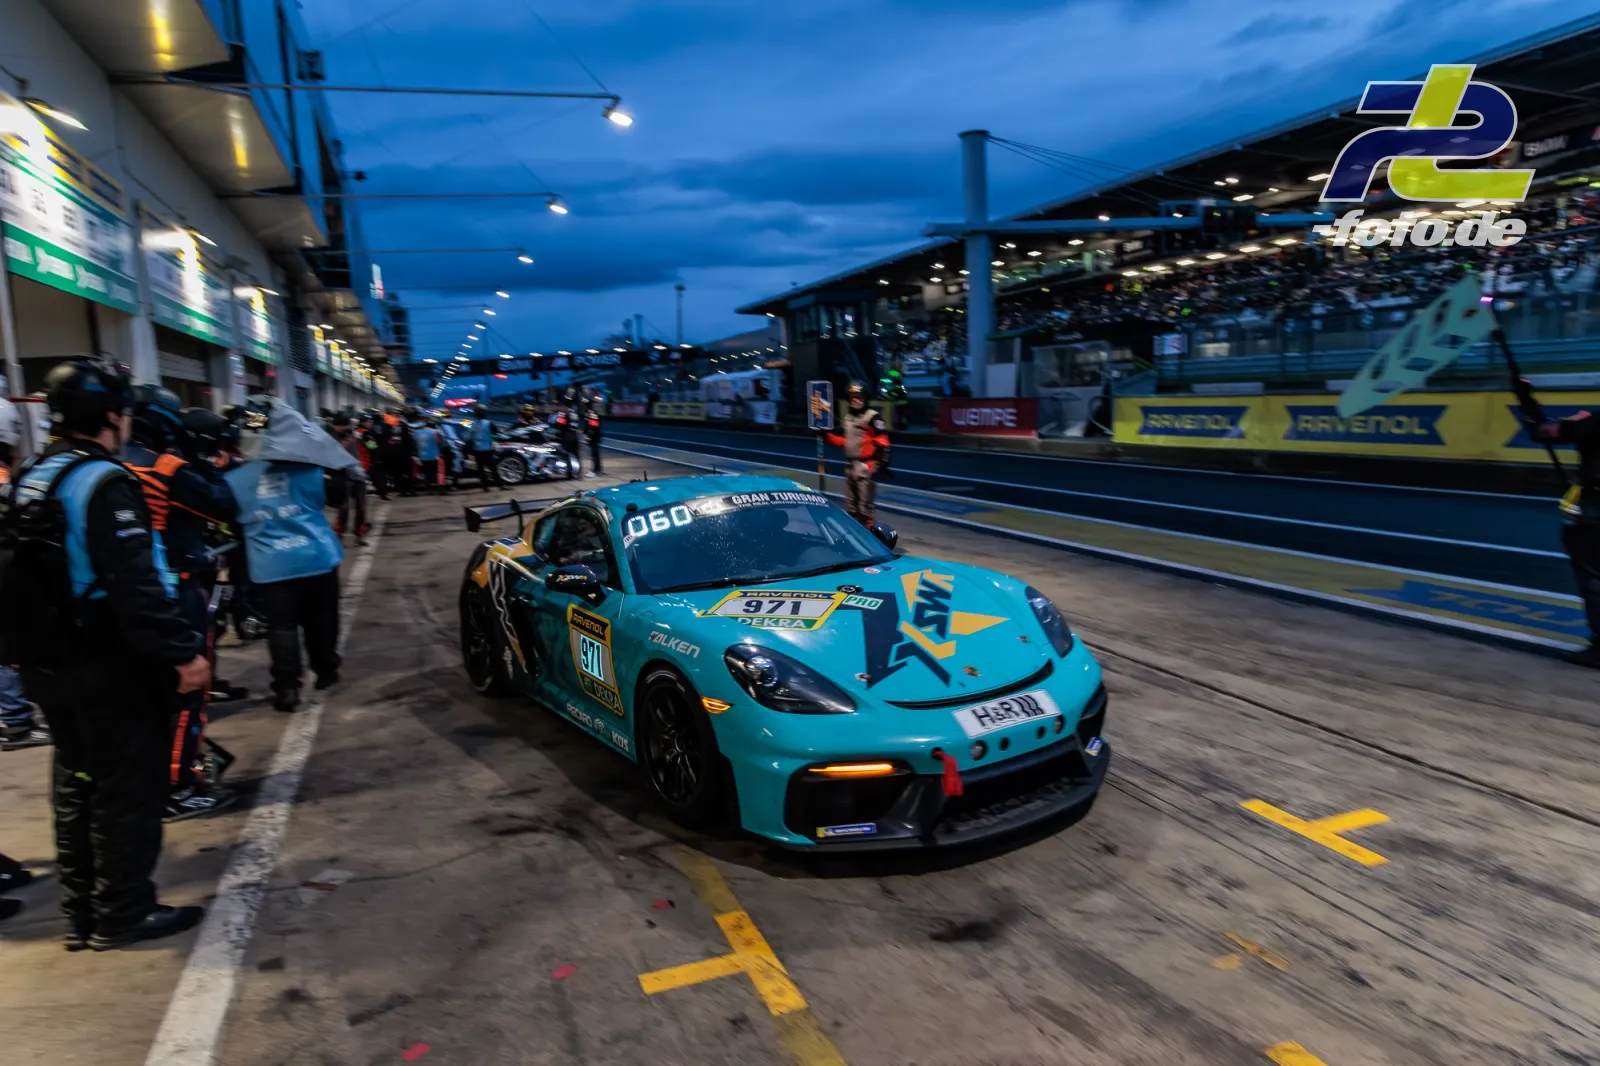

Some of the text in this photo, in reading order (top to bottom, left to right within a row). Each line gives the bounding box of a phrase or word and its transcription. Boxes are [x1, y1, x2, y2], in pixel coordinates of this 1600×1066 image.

[950, 407, 1018, 427] WEMPE
[1146, 413, 1236, 431] RAVENOL
[1297, 414, 1431, 436] RAVENOL
[732, 491, 826, 504] GRAN TURISMO
[627, 505, 692, 537] 060
[746, 591, 829, 599] RAVENOL
[845, 596, 880, 609] PRO
[742, 599, 802, 616] 971
[572, 613, 605, 635] RAVENOL
[737, 617, 806, 629] DEKRA
[648, 630, 701, 659] FALKEN
[581, 637, 602, 678] 971
[594, 682, 621, 709] DEKRA
